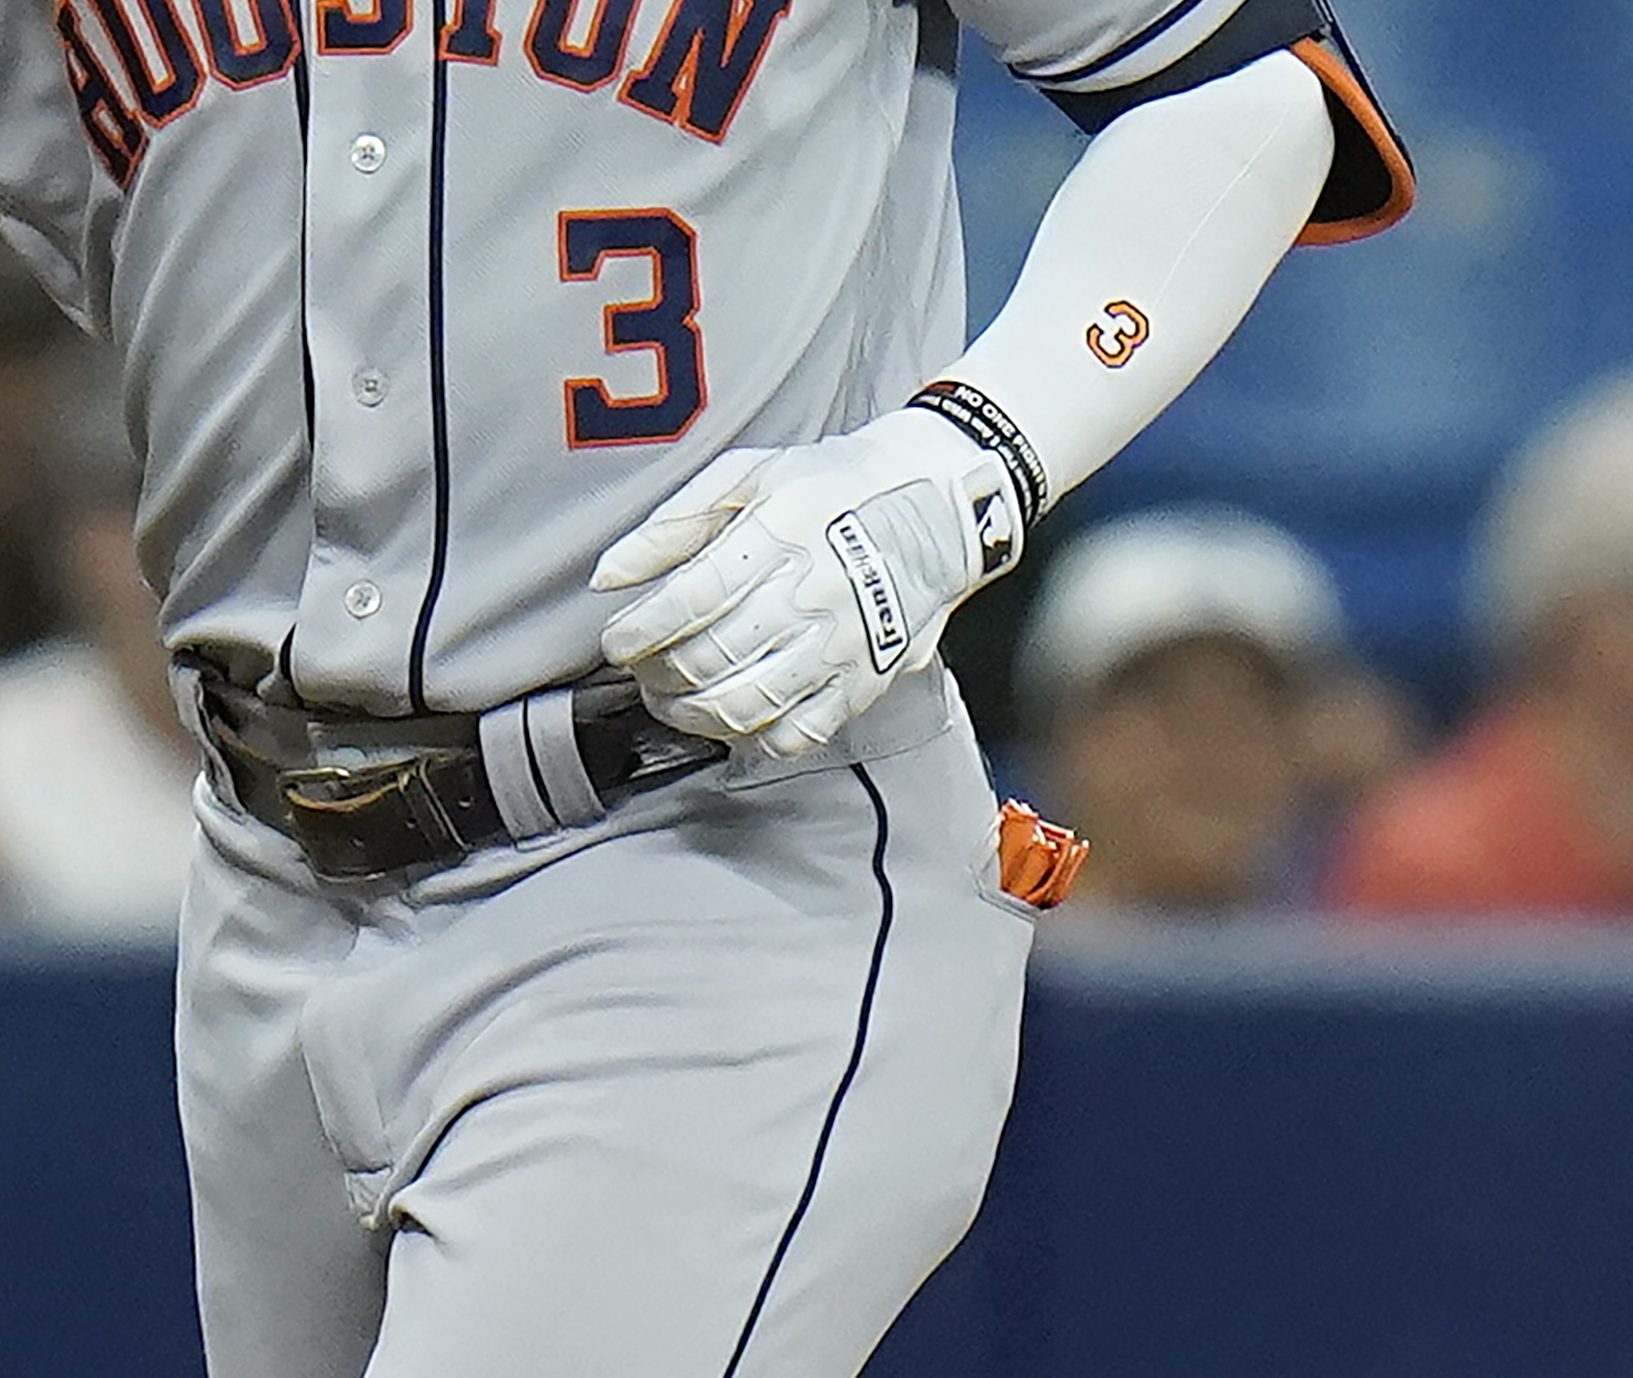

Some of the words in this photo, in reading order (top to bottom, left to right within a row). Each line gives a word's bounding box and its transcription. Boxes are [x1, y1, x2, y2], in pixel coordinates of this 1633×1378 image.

[557, 206, 708, 452] 3
[1085, 298, 1151, 370] 3
[954, 385, 983, 409] NO
[839, 525, 904, 652] Franklin
